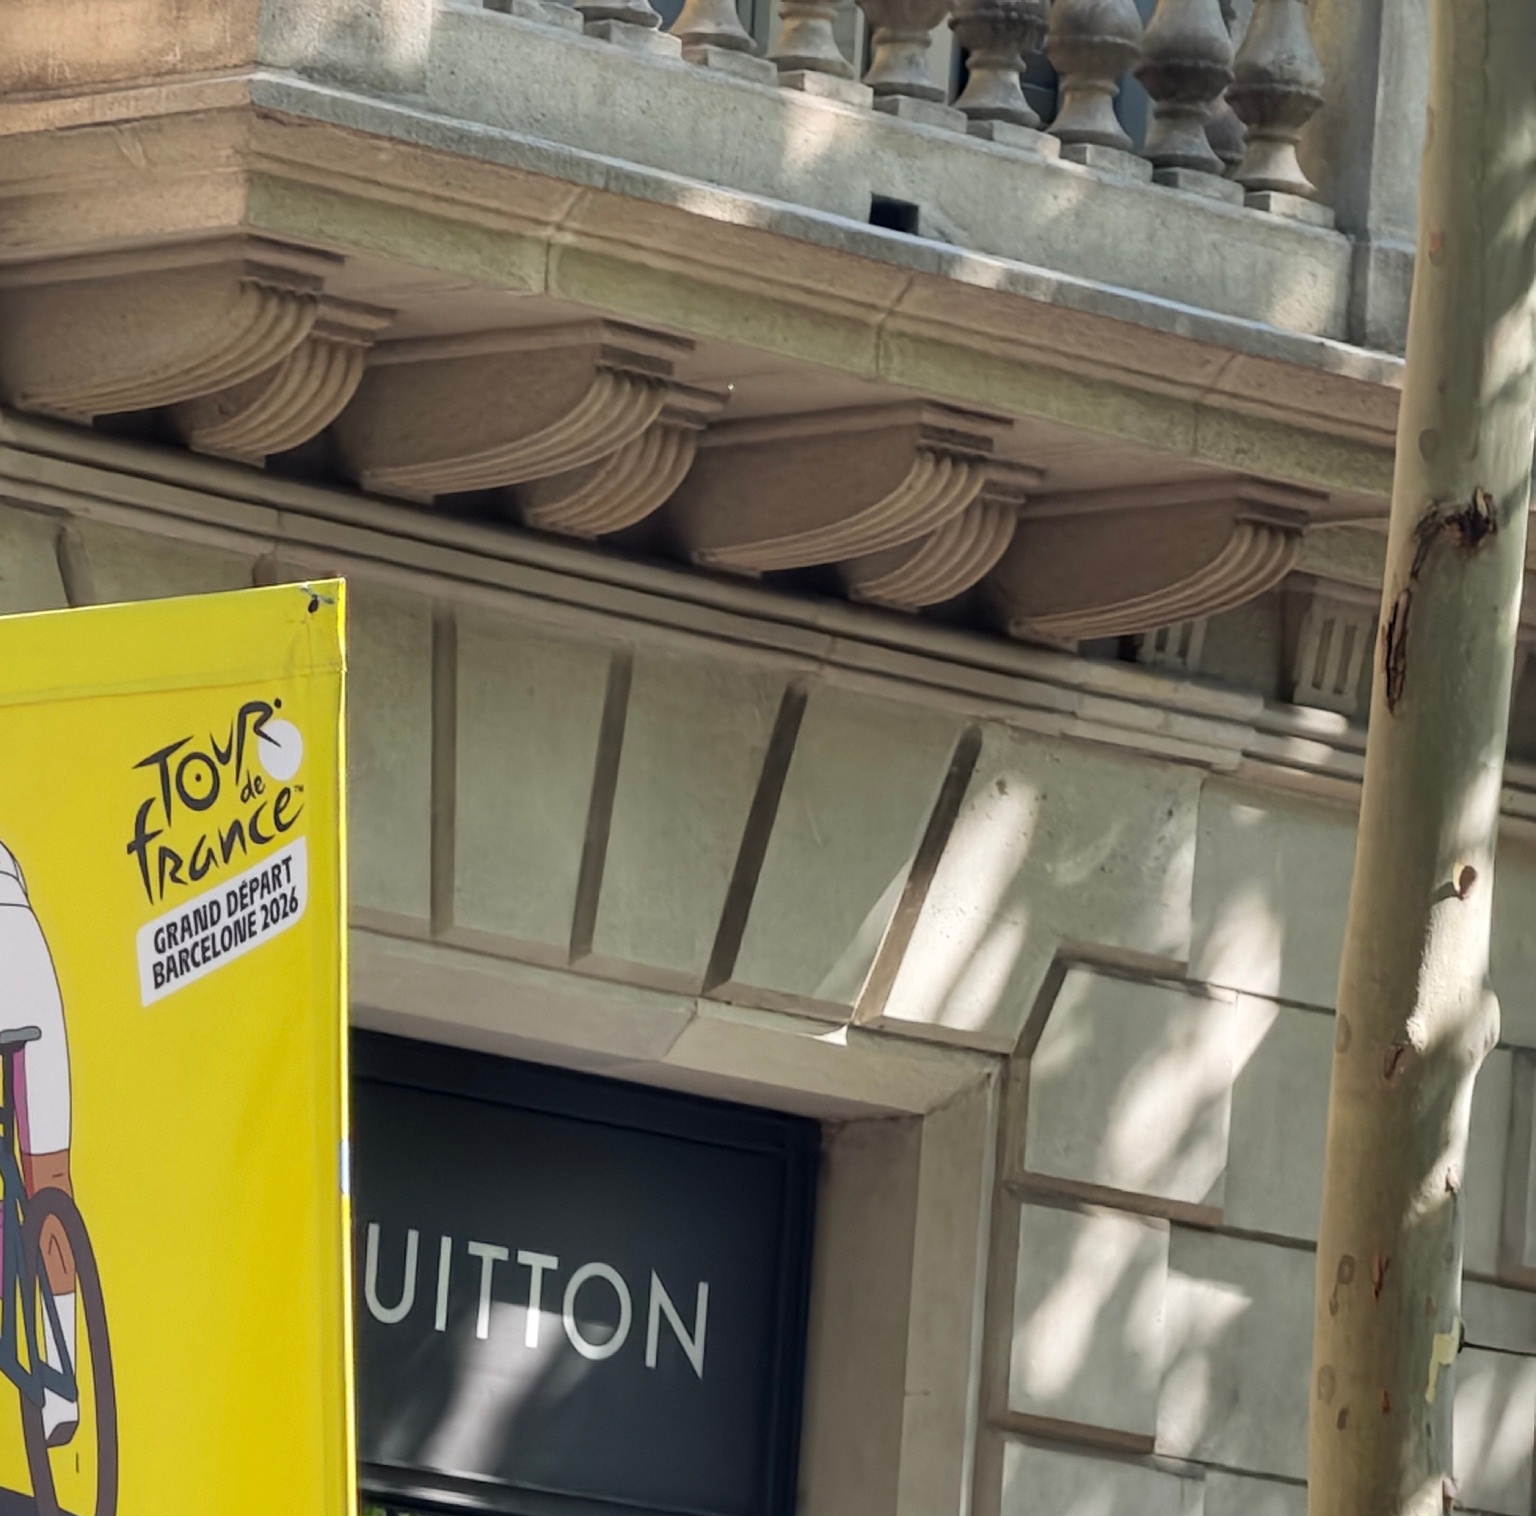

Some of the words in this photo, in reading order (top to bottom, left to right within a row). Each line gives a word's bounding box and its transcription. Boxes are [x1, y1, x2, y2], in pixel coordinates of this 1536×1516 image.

[132, 698, 281, 827] TOUR
[240, 769, 265, 804] de
[152, 911, 257, 990] BARCELONE
[261, 886, 299, 932] 2026
[154, 899, 221, 954] GRAND
[226, 855, 292, 913] DÉPART
[364, 1222, 709, 1380] UITTON
